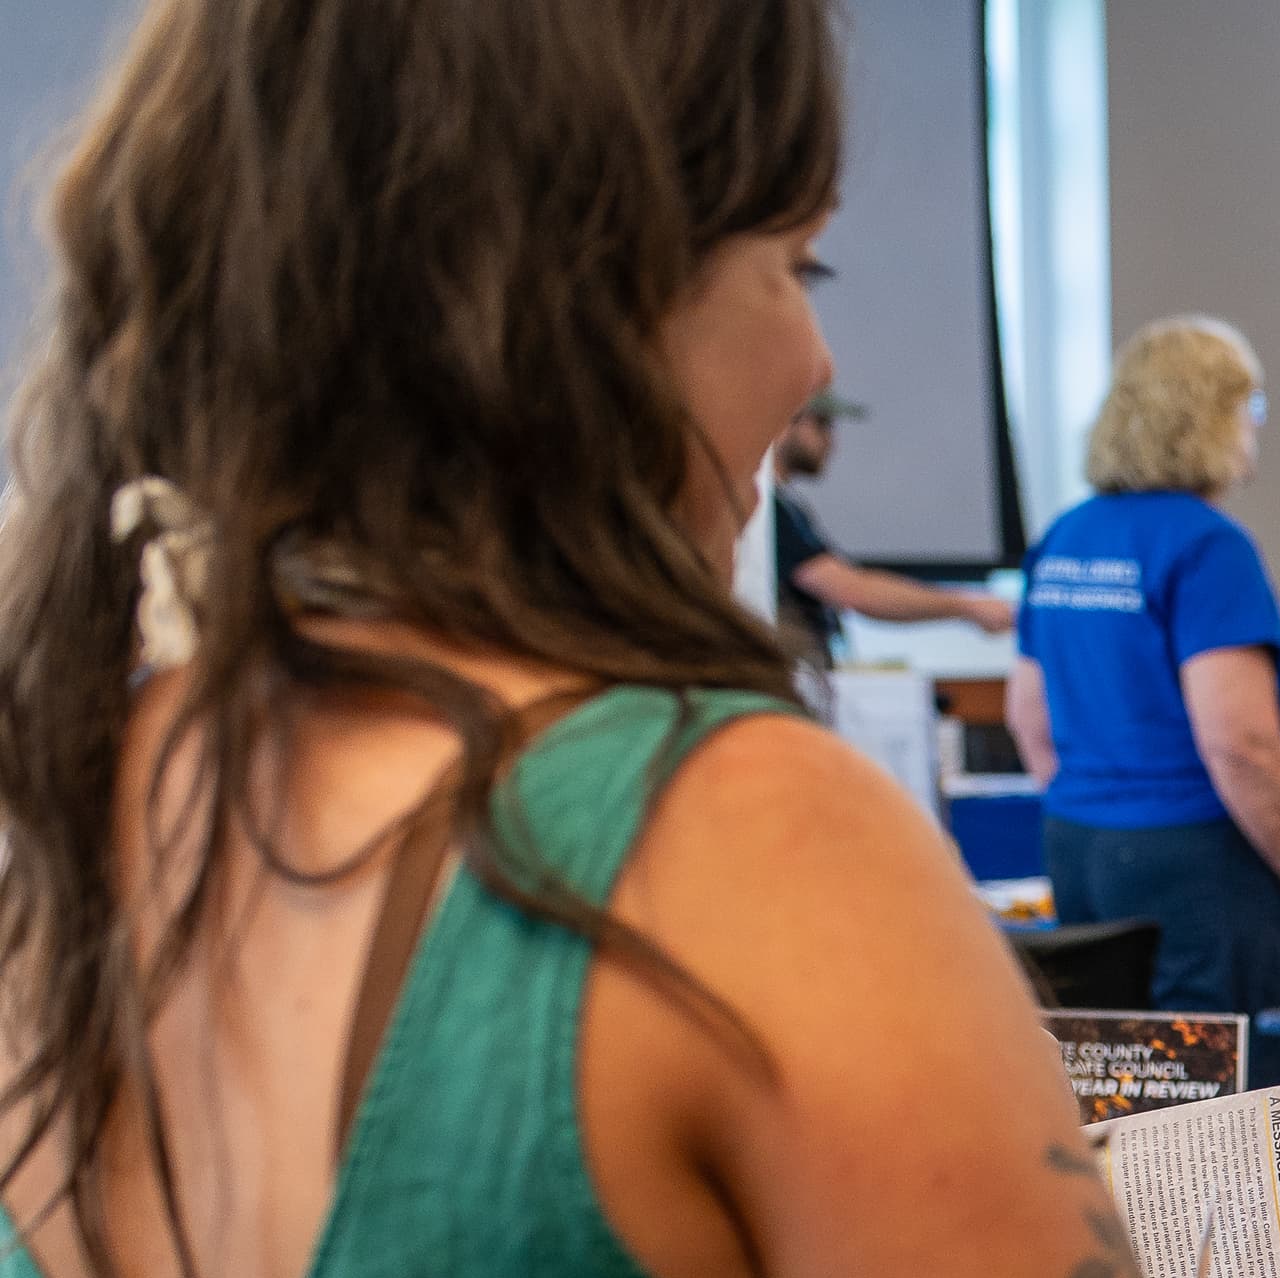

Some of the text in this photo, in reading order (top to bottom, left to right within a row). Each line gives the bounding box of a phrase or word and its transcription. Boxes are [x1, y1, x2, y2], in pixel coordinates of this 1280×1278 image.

[1079, 1042, 1153, 1062] COUNTY
[1108, 1061, 1188, 1080] COUNCIL
[1072, 1079, 1220, 1099] YEAR IN REVIEW
[1268, 1094, 1280, 1107] A
